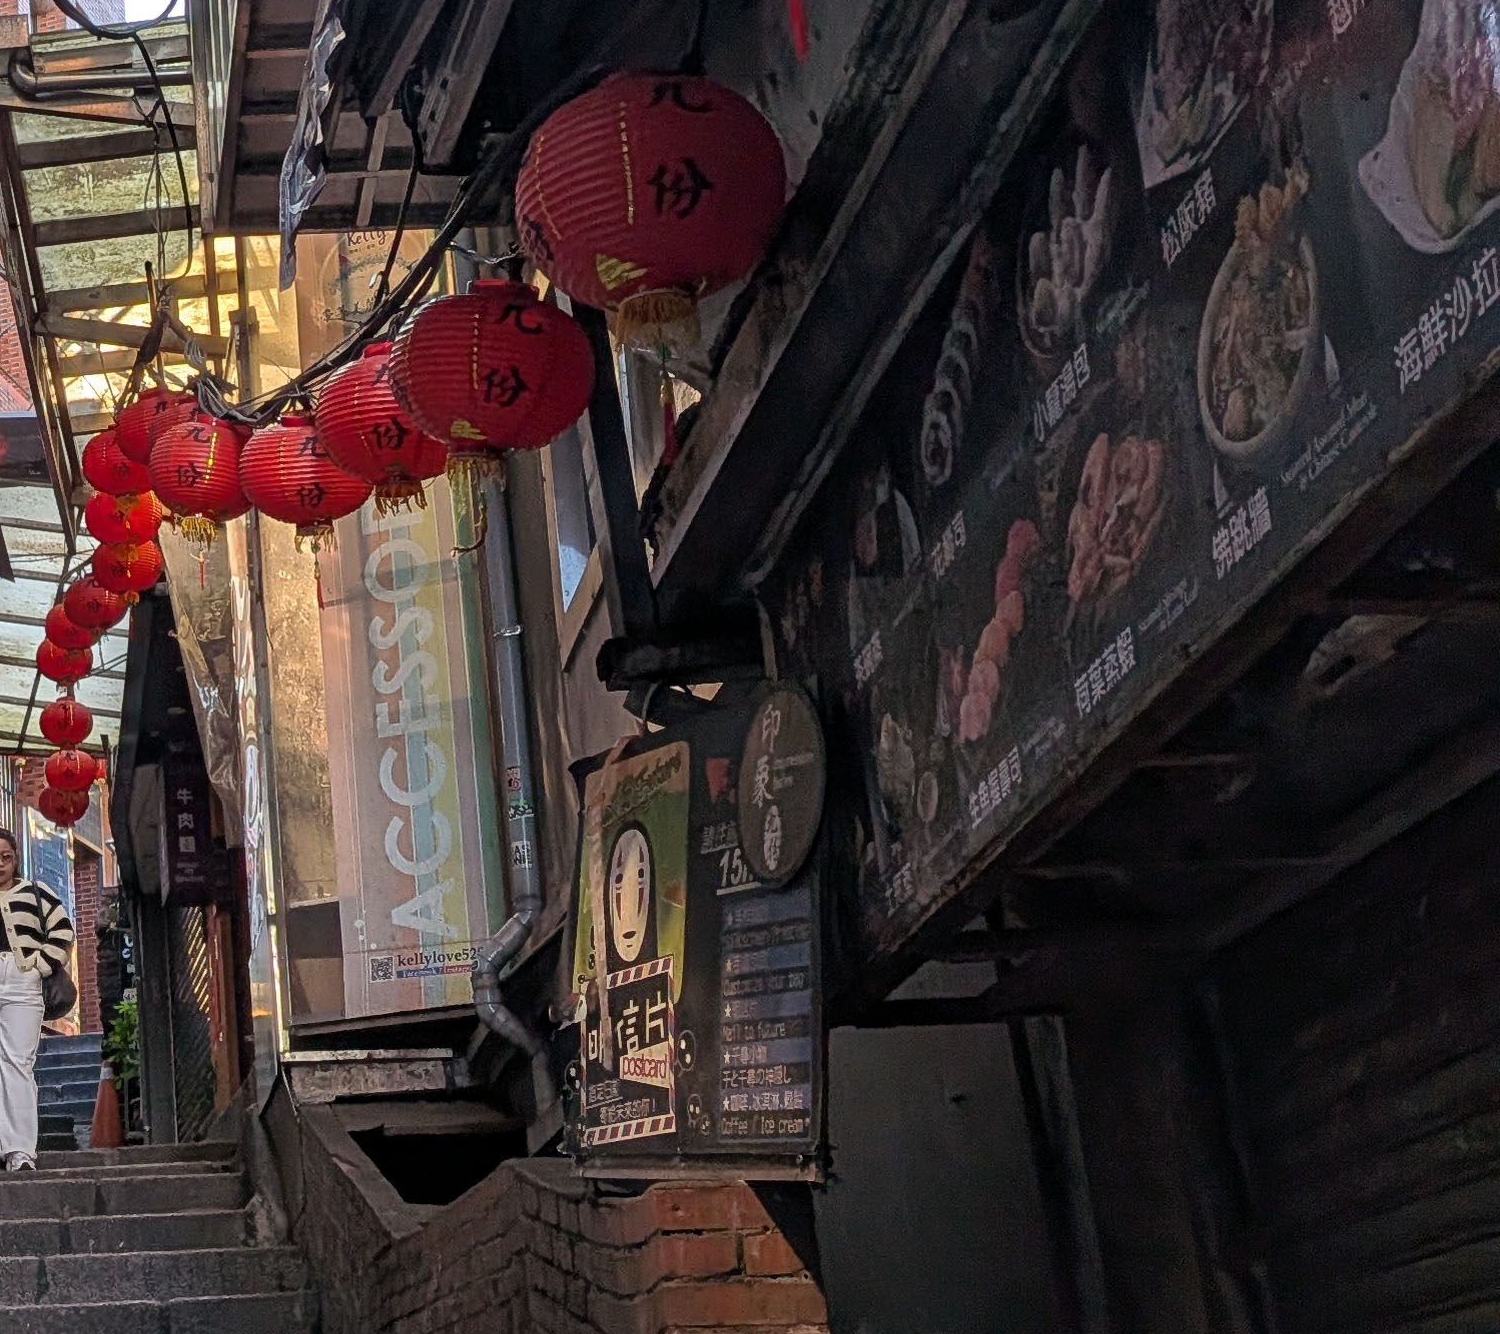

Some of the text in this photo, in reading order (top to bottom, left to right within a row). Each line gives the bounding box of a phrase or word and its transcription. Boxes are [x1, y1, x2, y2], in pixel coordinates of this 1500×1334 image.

[648, 82, 715, 219] 九份
[1160, 165, 1217, 270] 松阪豬
[484, 304, 542, 407] 九份
[1393, 246, 1500, 395] 海鮮沙拉
[177, 426, 210, 486] 九份
[298, 435, 329, 506] 九份
[622, 1053, 669, 1080] postcard
